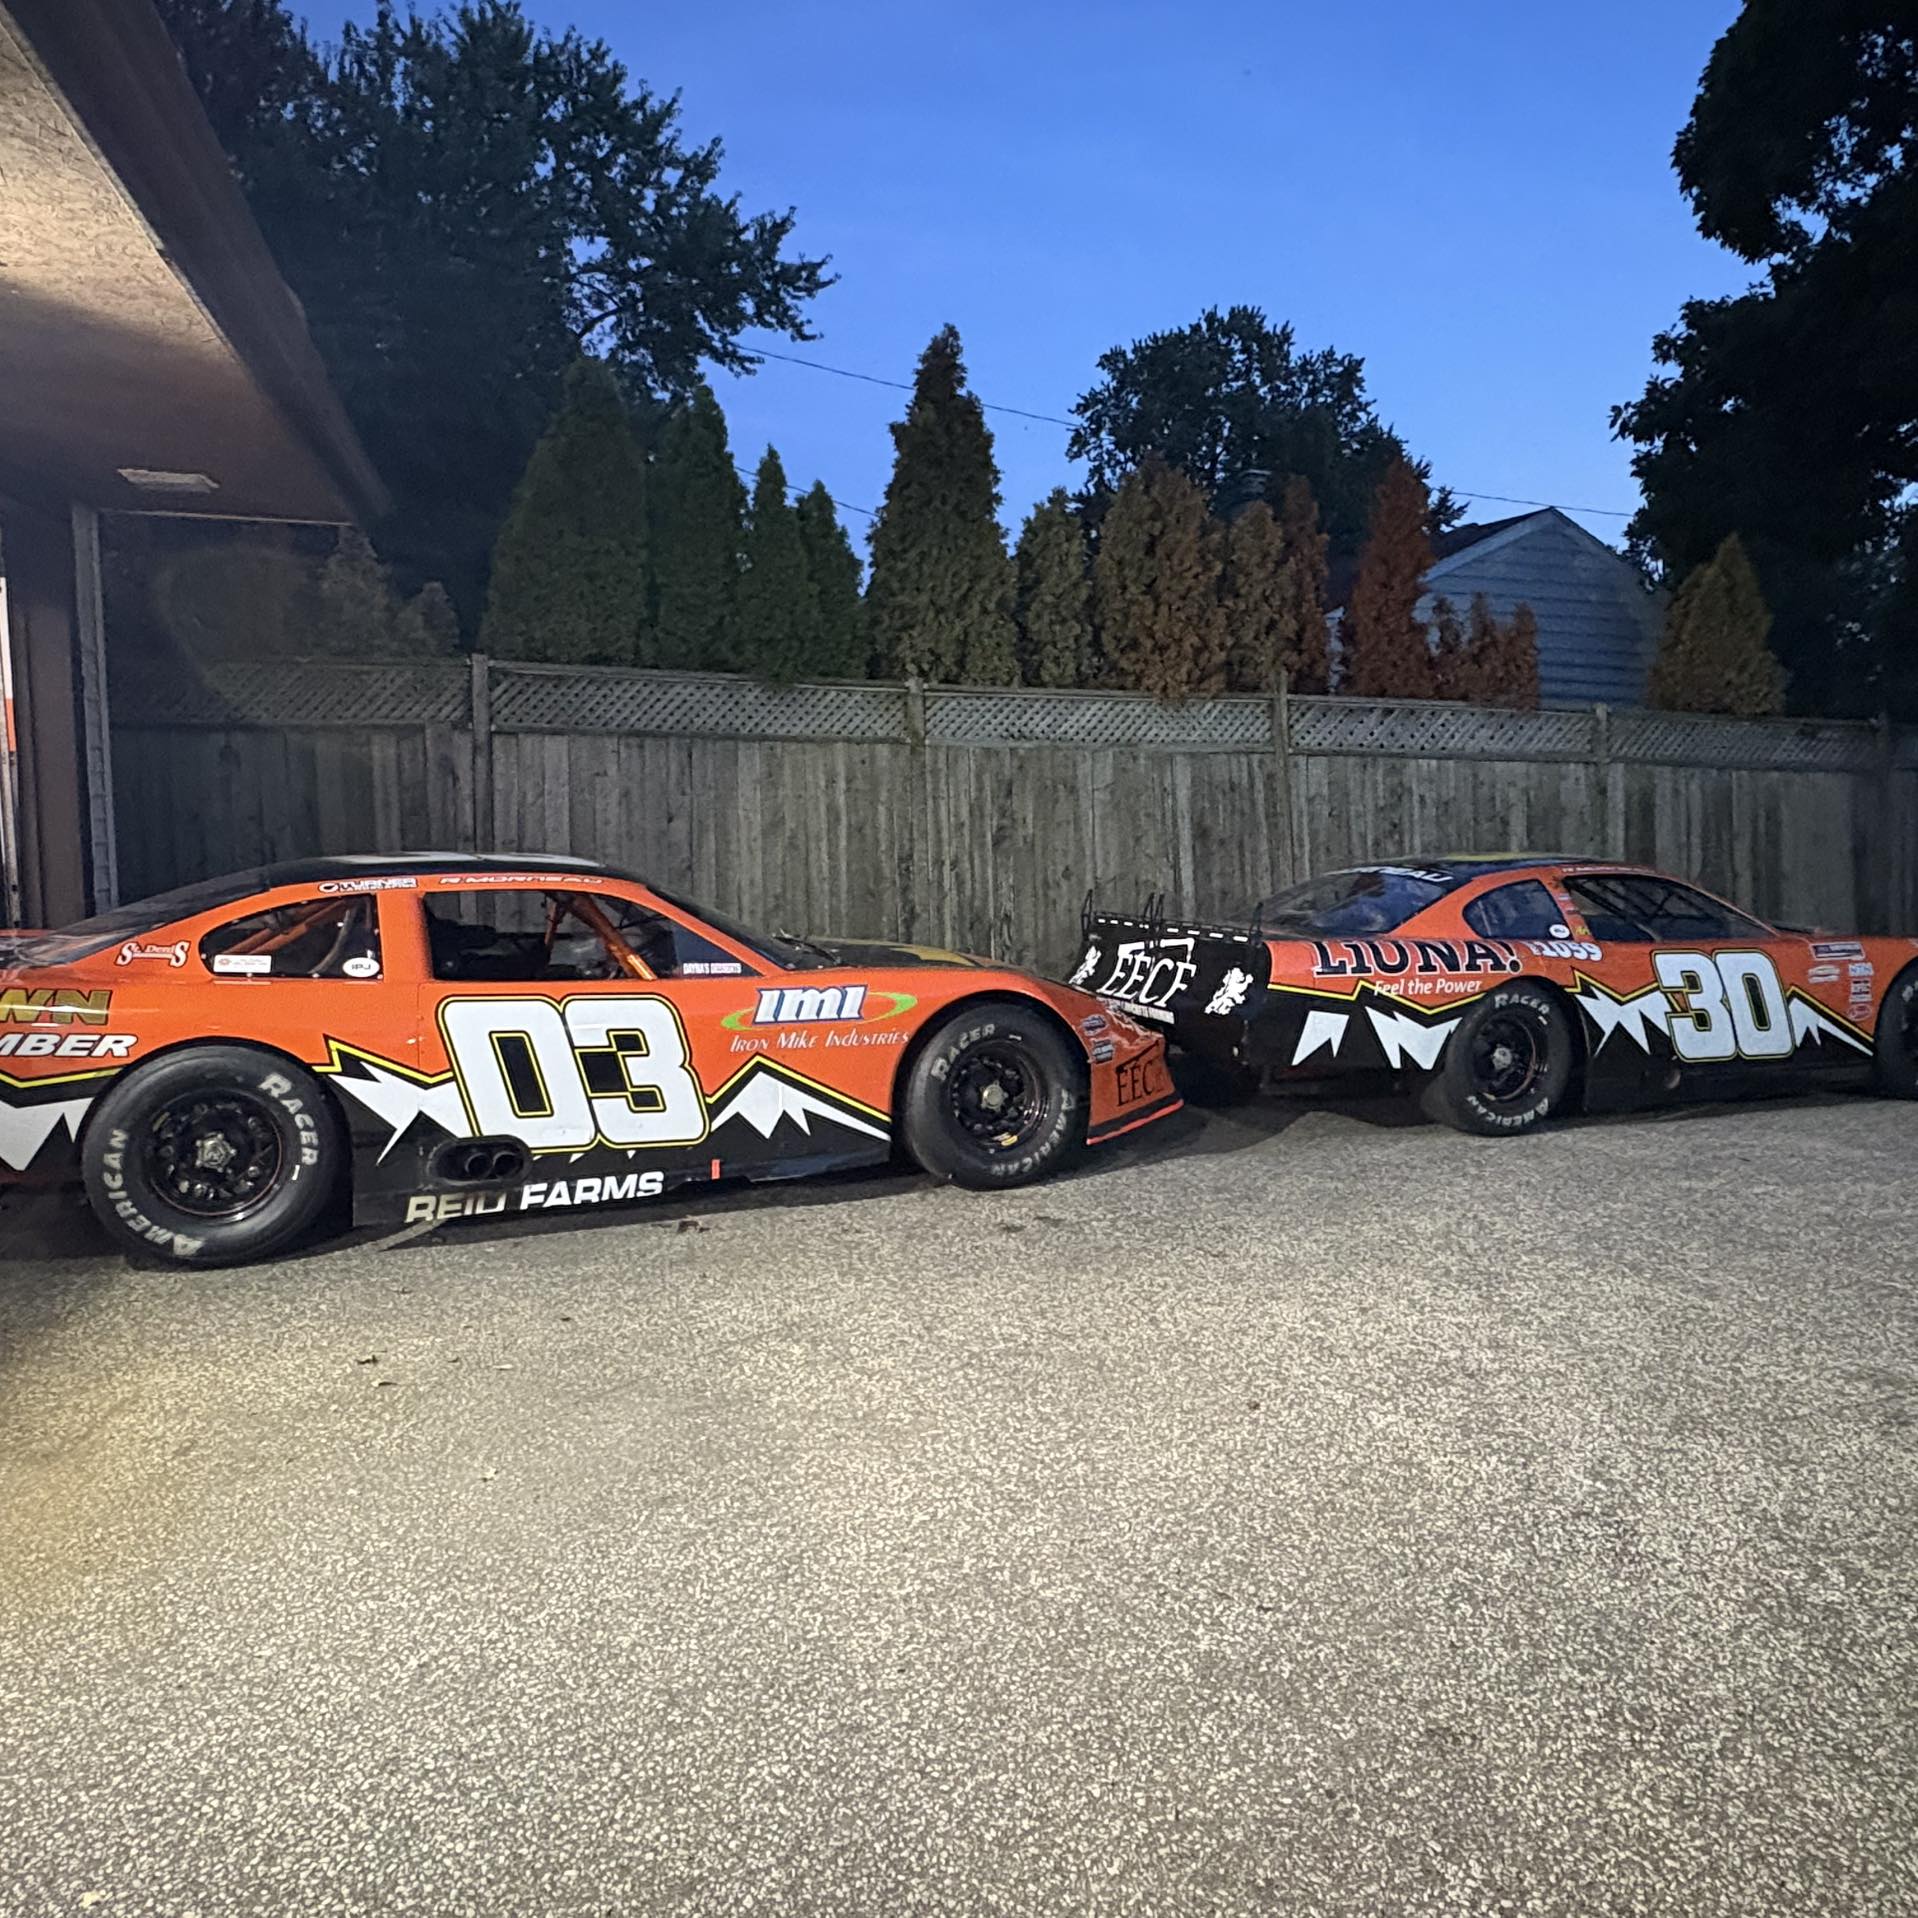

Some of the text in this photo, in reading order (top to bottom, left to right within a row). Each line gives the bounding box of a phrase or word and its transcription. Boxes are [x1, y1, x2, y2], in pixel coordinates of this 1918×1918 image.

[1374, 977, 1483, 996] Feel the Power
[1494, 993, 1550, 1014] RACER
[1651, 948, 1796, 1063] 30
[435, 993, 712, 1154] 03
[930, 1023, 996, 1081] RACER
[257, 1072, 319, 1166] RACER
[103, 1128, 206, 1256] AMERICAN
[520, 1171, 665, 1210] FARMS
